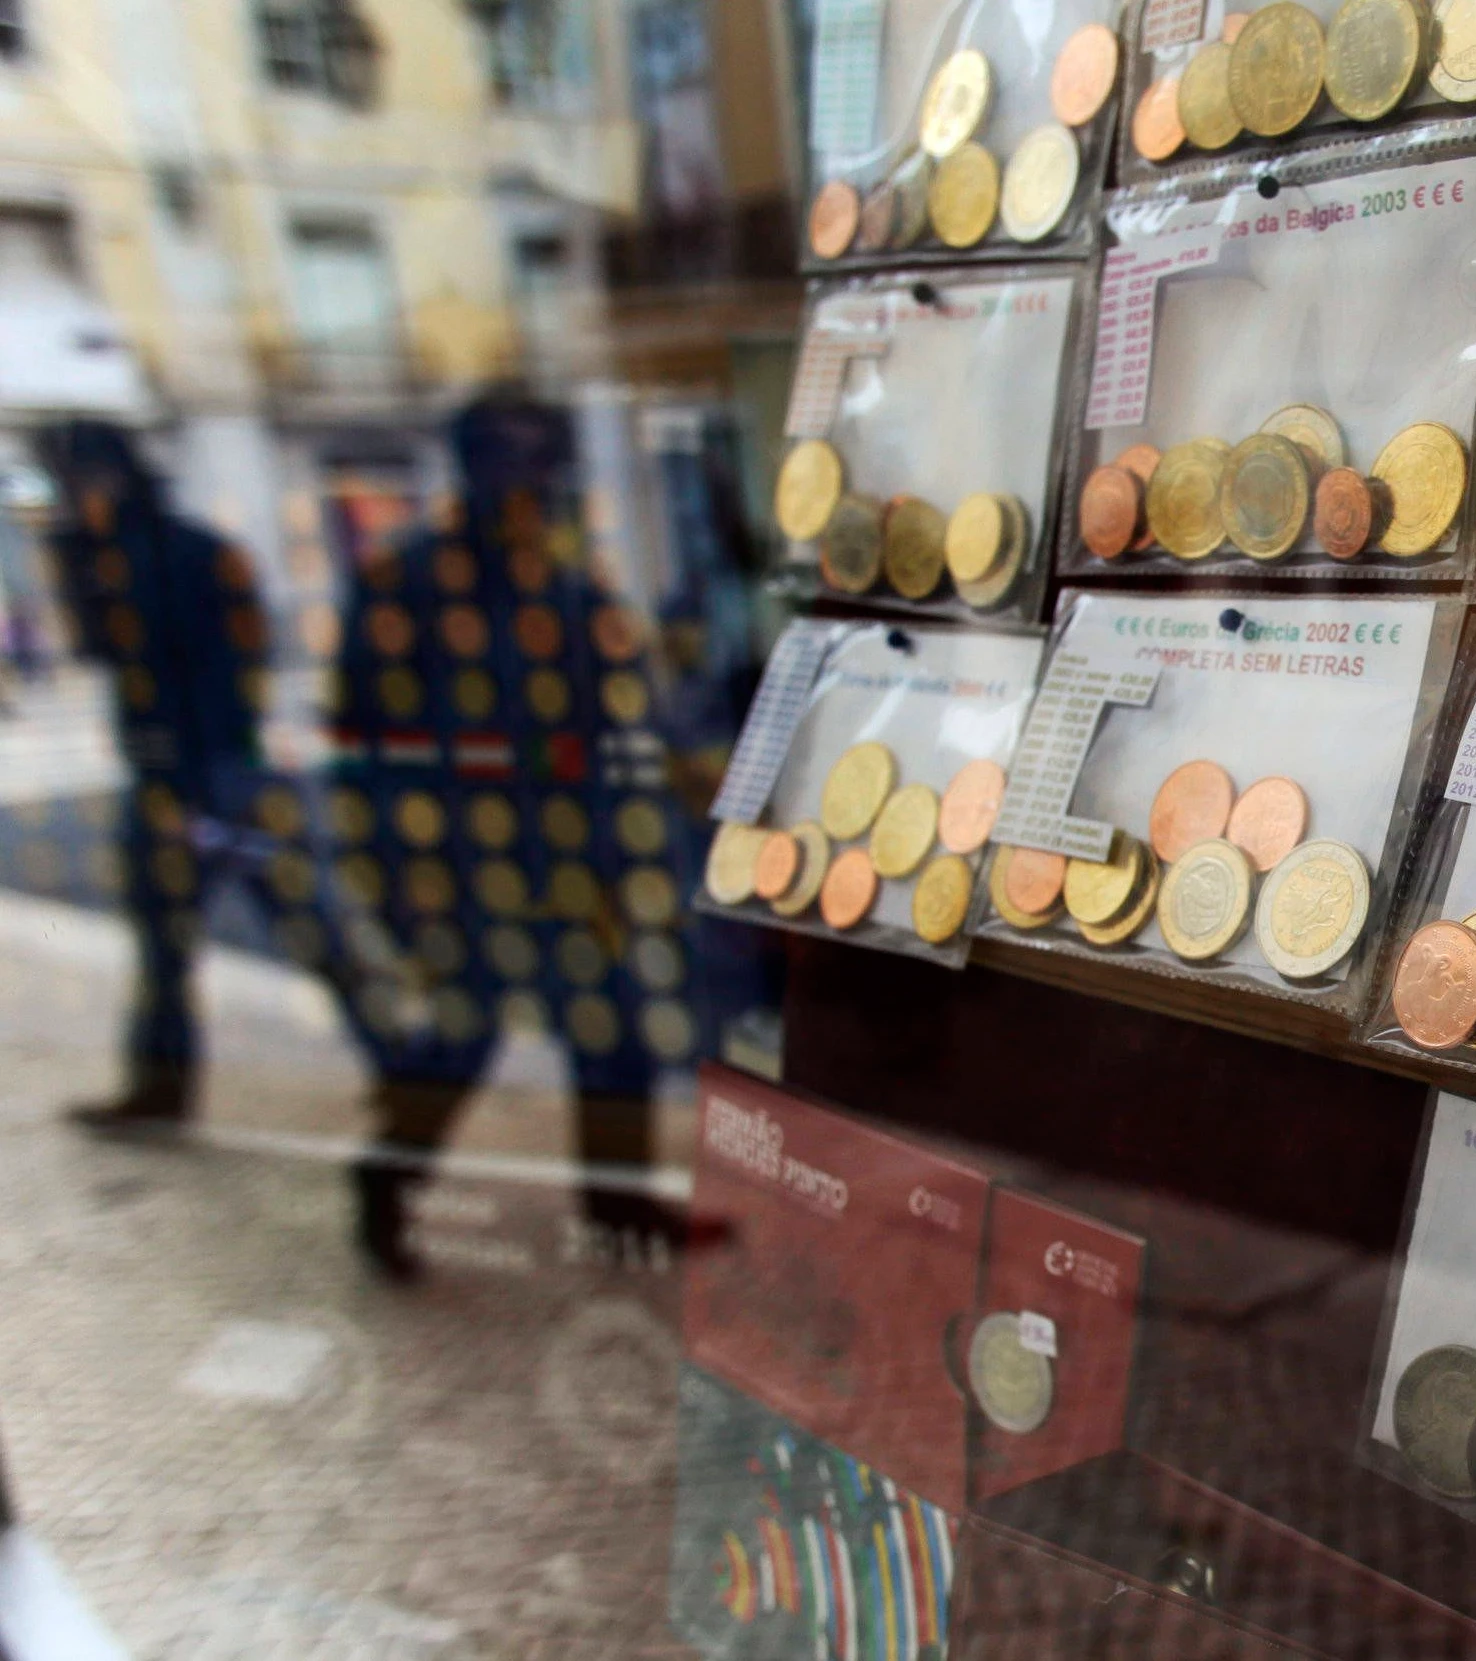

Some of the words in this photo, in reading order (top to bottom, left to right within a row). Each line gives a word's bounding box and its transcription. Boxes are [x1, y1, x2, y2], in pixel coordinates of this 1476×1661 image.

[1255, 213, 1280, 234] da
[1361, 189, 1406, 218] 2003
[1159, 619, 1209, 639] Euros
[1242, 619, 1300, 641] Grécia
[1306, 622, 1351, 644] 2002
[1241, 652, 1282, 672] SEM
[1286, 653, 1365, 677] LETRAS
